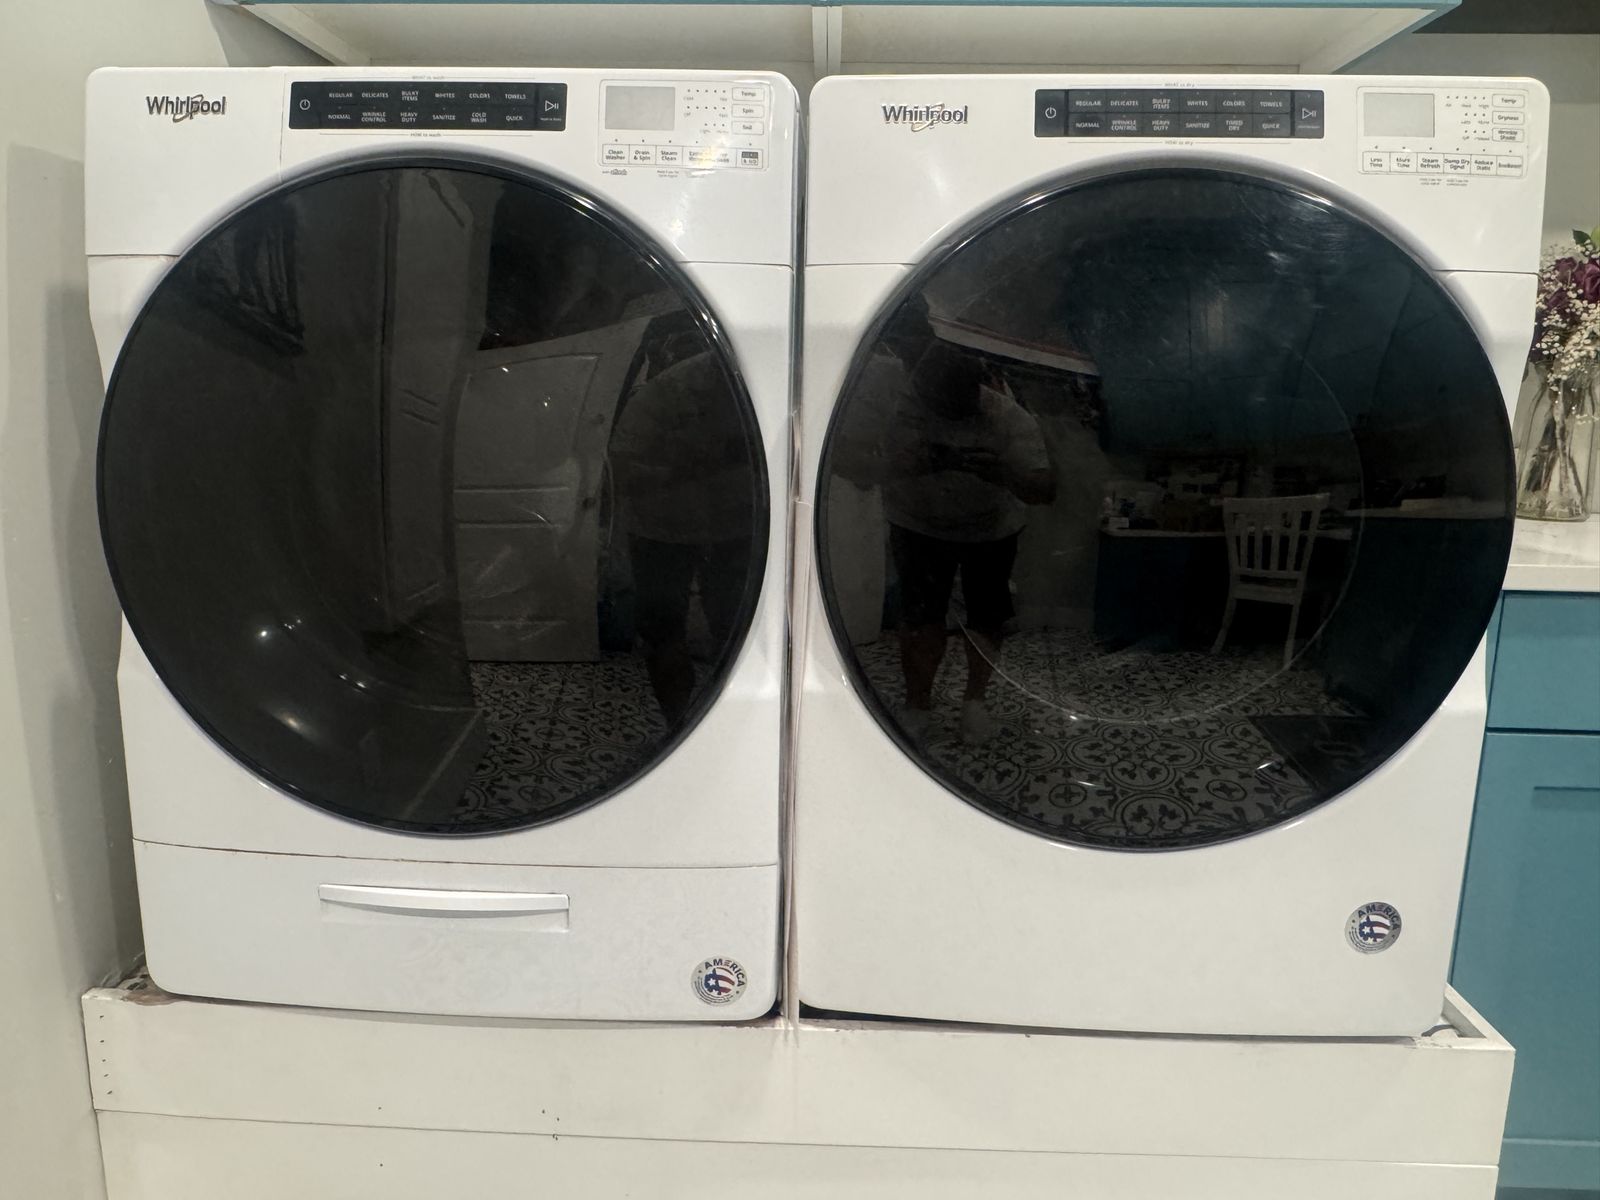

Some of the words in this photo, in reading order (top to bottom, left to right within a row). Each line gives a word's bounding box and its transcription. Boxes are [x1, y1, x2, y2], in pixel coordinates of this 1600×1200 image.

[146, 94, 226, 123] Whirlpool
[882, 103, 968, 132] Whirlpool
[705, 958, 745, 987] AMERICA
